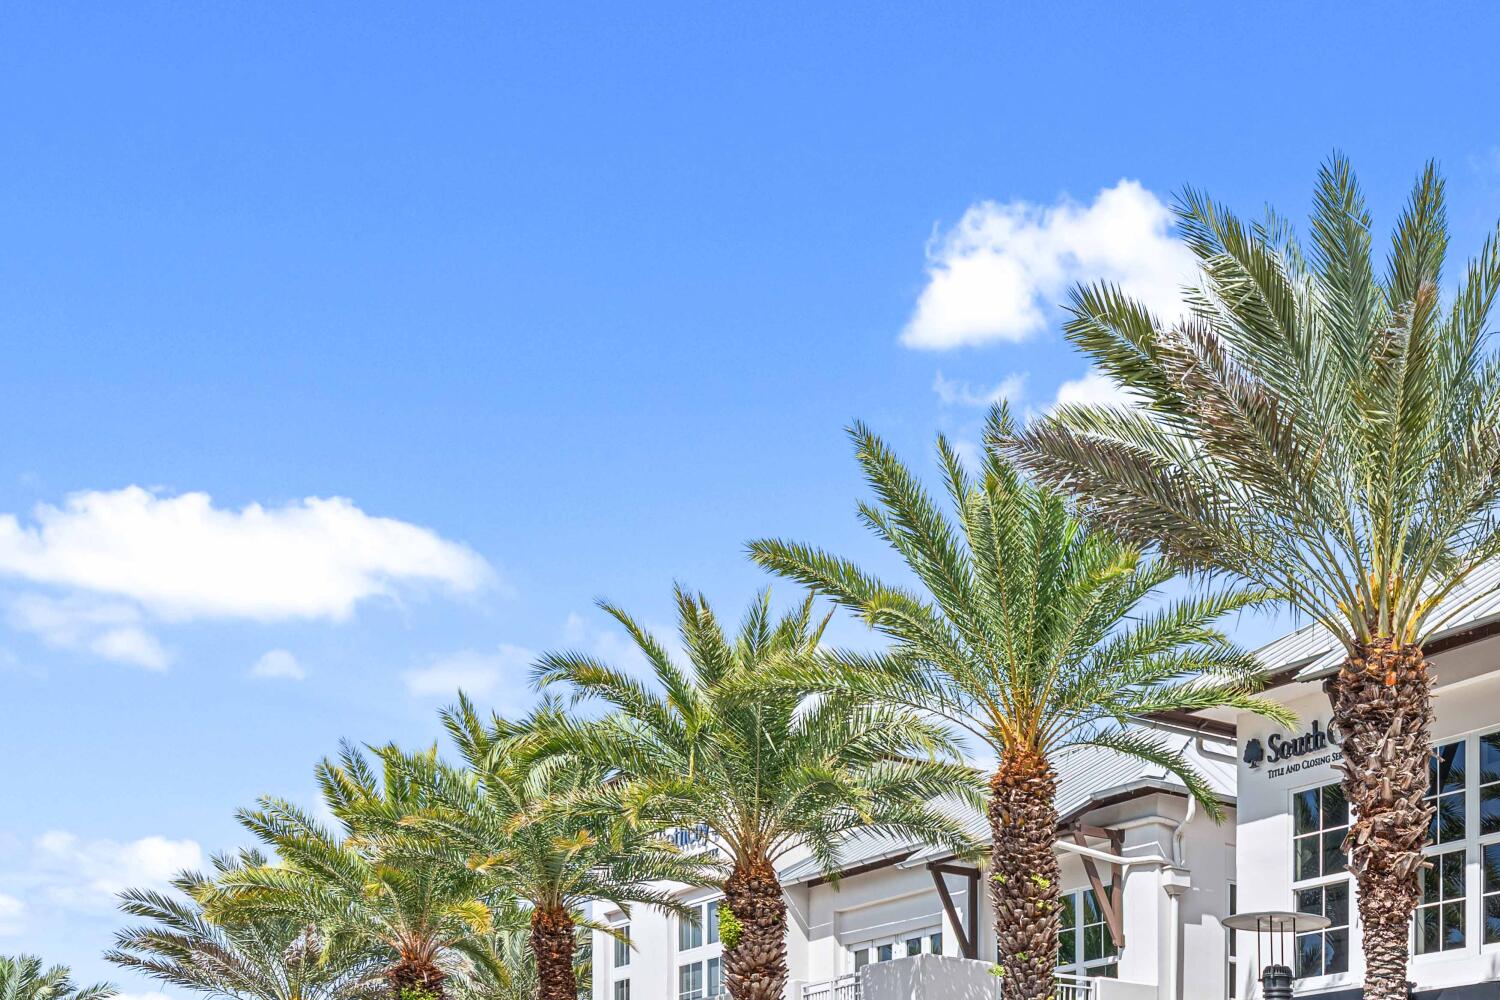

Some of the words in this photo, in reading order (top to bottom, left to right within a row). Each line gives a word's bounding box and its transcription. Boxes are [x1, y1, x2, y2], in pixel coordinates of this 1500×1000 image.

[1267, 720, 1327, 763] South
[1286, 763, 1301, 775] AND
[1302, 754, 1331, 770] CLOSING
